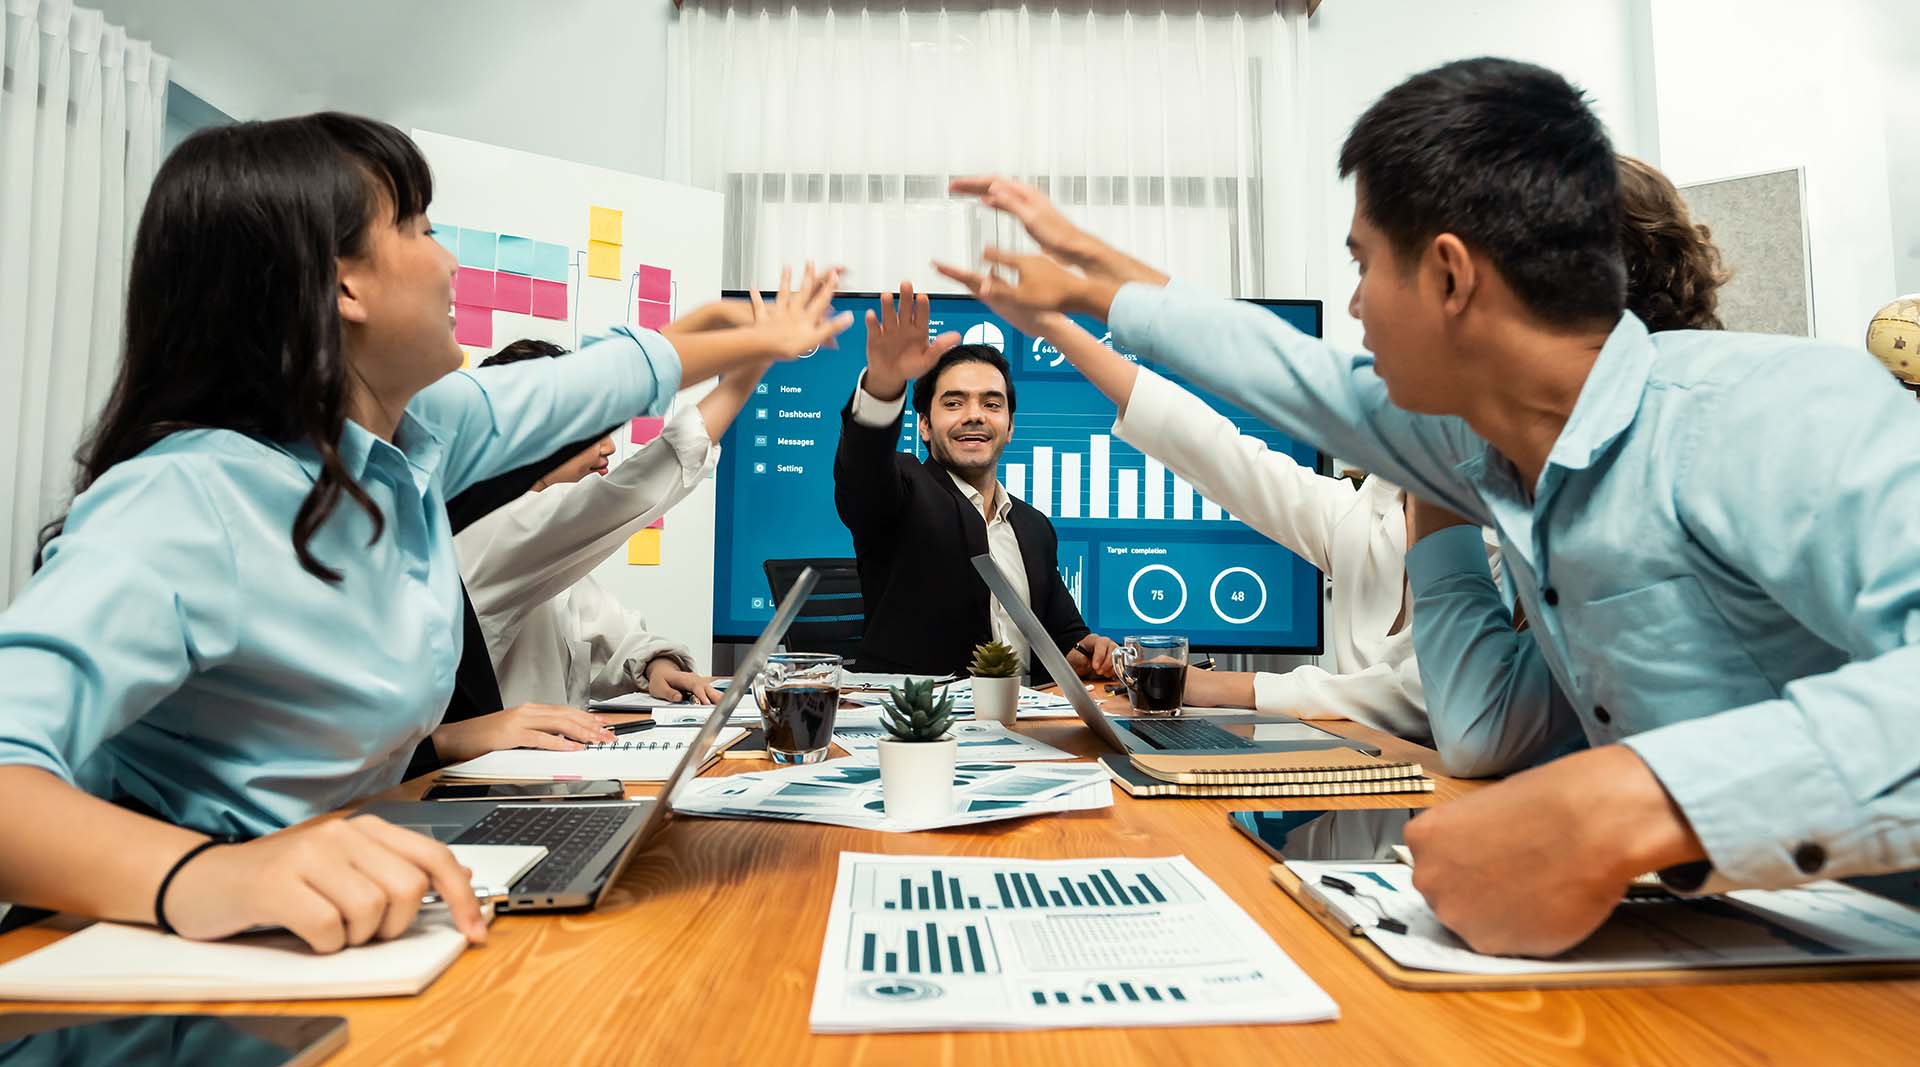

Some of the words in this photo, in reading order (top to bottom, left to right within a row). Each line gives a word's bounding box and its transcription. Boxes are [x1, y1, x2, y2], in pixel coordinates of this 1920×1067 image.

[1041, 345, 1058, 354] 64%
[780, 385, 802, 393] Home
[778, 409, 821, 418] Dashboard
[777, 437, 815, 447] Messages
[776, 464, 804, 474] Setting
[1107, 546, 1128, 555] Target
[1130, 547, 1167, 555] completion
[1151, 590, 1164, 601] 75
[1231, 591, 1245, 602] 48
